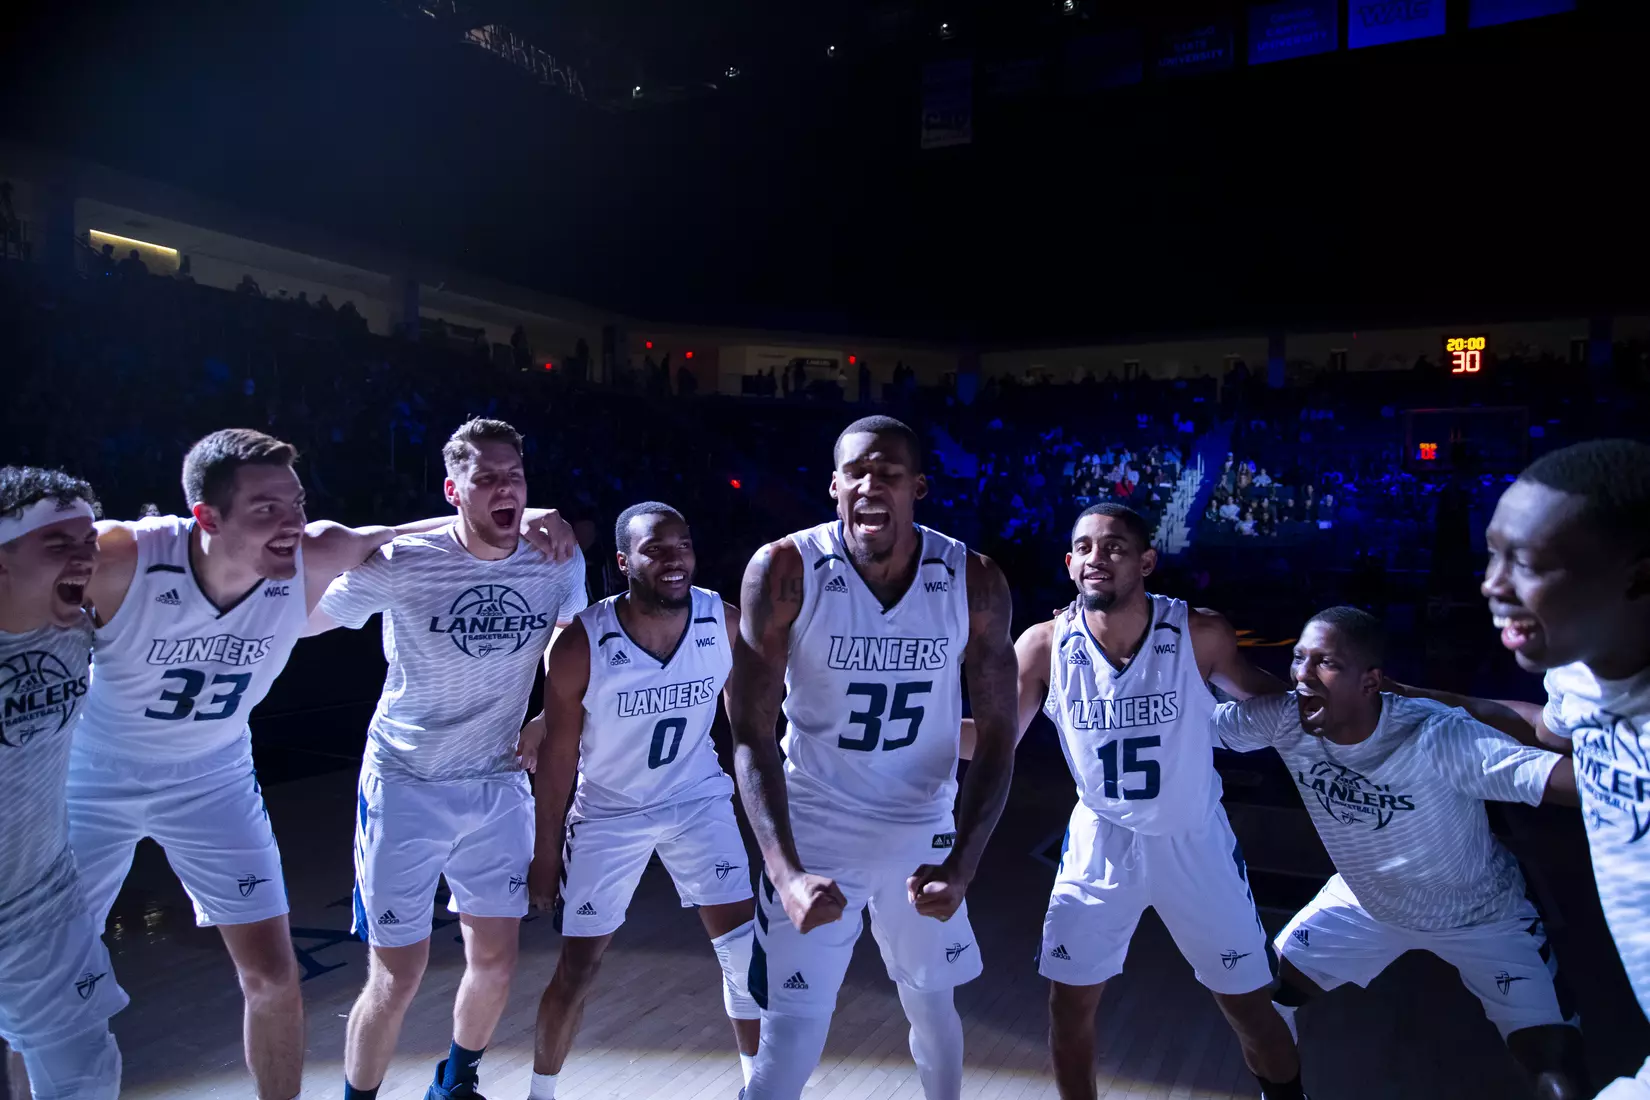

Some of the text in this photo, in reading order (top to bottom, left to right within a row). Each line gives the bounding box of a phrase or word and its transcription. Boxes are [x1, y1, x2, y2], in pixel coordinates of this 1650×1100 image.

[1446, 336, 1486, 352] 20:00
[1452, 350, 1480, 373] 30
[264, 585, 290, 598] WAC
[924, 581, 947, 593] WAC
[429, 612, 548, 634] LANCERS
[468, 632, 516, 641] BASKETBALL
[146, 633, 274, 667] LANCERS
[695, 636, 716, 648] WAC
[827, 635, 949, 671] LANCERS
[1154, 643, 1176, 655] WAC
[0, 675, 88, 719] NCERS
[144, 667, 253, 722] 33
[617, 676, 715, 718] LANCERS
[1073, 691, 1179, 730] LANCERS
[838, 680, 934, 752] 35
[647, 716, 688, 770] 0
[1097, 734, 1162, 801] 15
[1298, 768, 1416, 811] LANCERS
